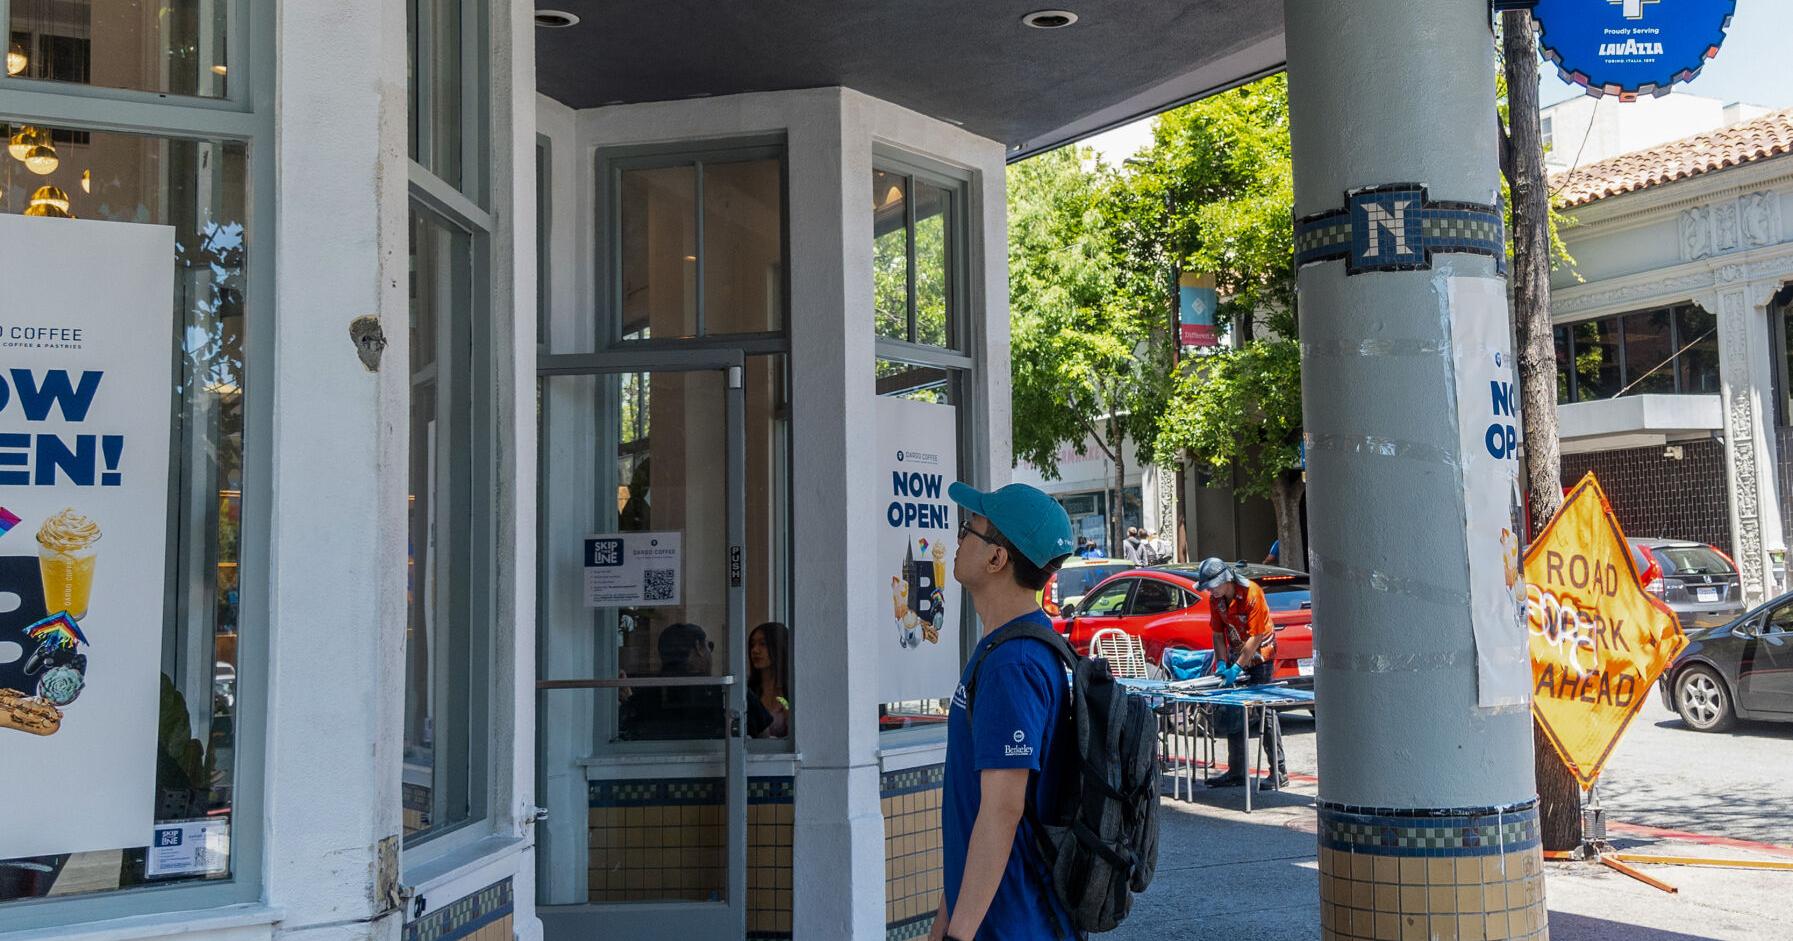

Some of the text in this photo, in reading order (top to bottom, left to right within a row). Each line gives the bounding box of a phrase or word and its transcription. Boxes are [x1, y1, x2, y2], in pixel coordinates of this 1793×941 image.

[1599, 38, 1664, 56] LAVAZZA
[1360, 200, 1413, 257] N
[11, 326, 82, 341] COFFEE
[1485, 423, 1519, 460] OP
[892, 470, 943, 499] NOW
[887, 501, 949, 529] OPEN!
[594, 541, 618, 552] SKIP
[594, 551, 618, 564] LINE
[731, 546, 740, 578] PUSH
[1546, 550, 1619, 598] ROAD
[1535, 662, 1635, 708] AHEAD
[1004, 744, 1034, 756] Berkeley
